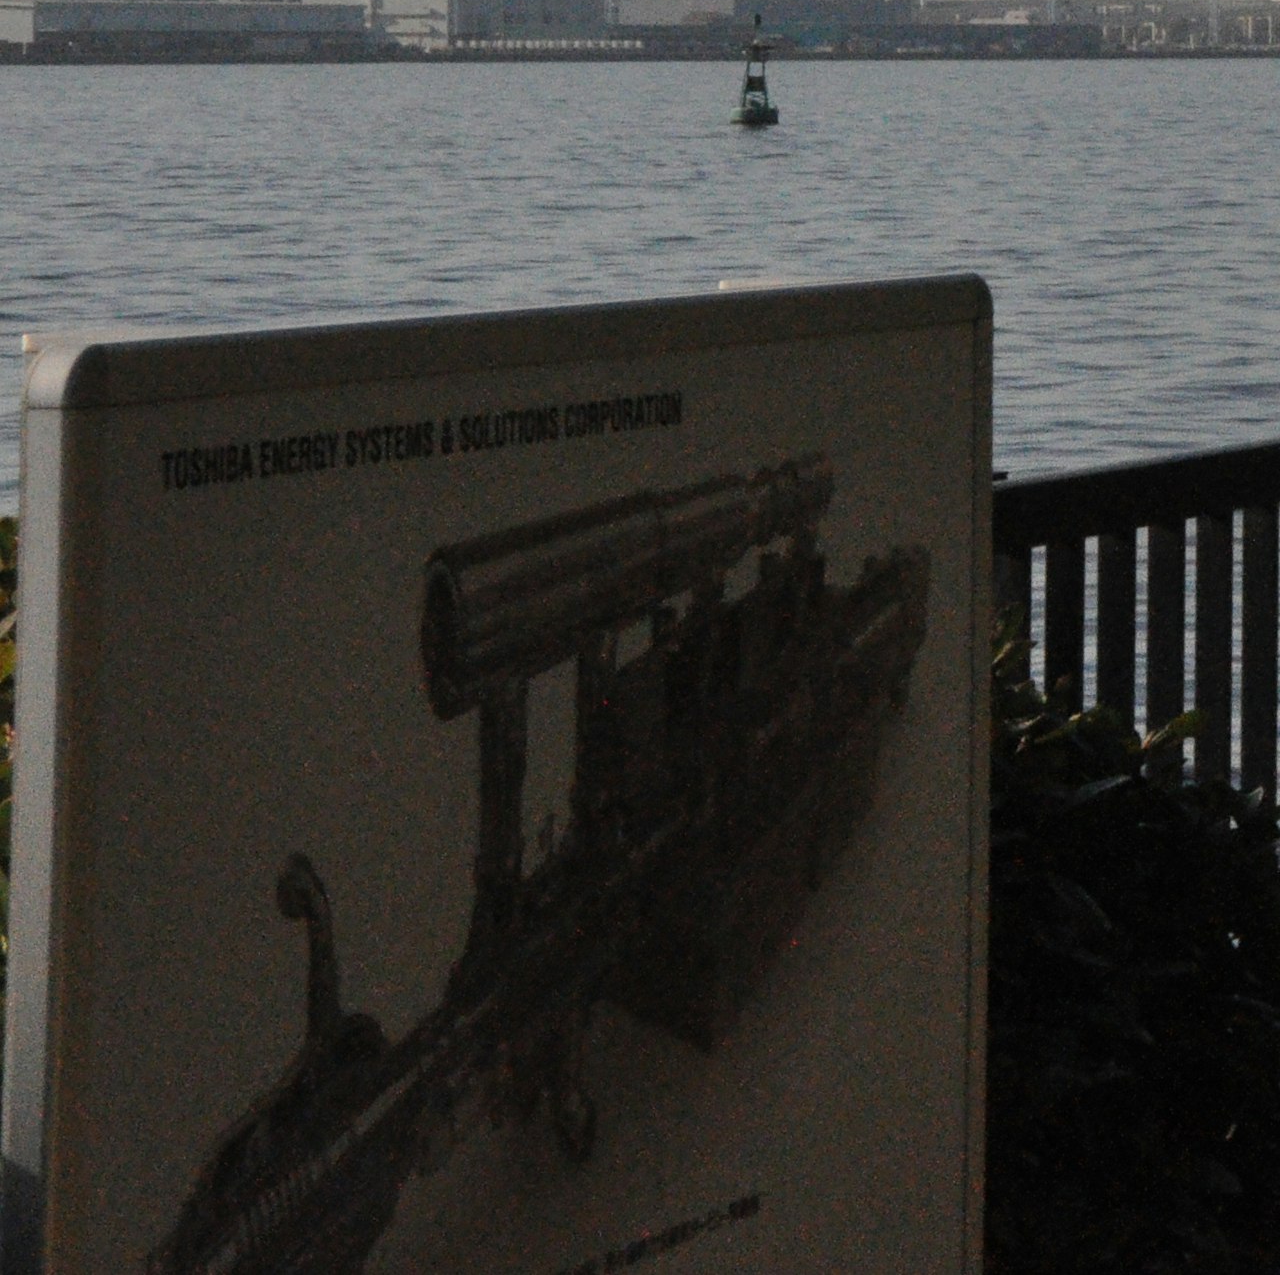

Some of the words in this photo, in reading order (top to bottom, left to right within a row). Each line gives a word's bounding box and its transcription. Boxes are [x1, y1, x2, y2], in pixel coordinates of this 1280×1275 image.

[161, 443, 253, 491] TOSHIBA
[259, 432, 340, 479] ENERGY
[345, 420, 433, 467] SYSTEMS
[440, 418, 454, 455] &
[459, 406, 559, 452] SOLUTIONS
[563, 390, 684, 439] CORPORATION
